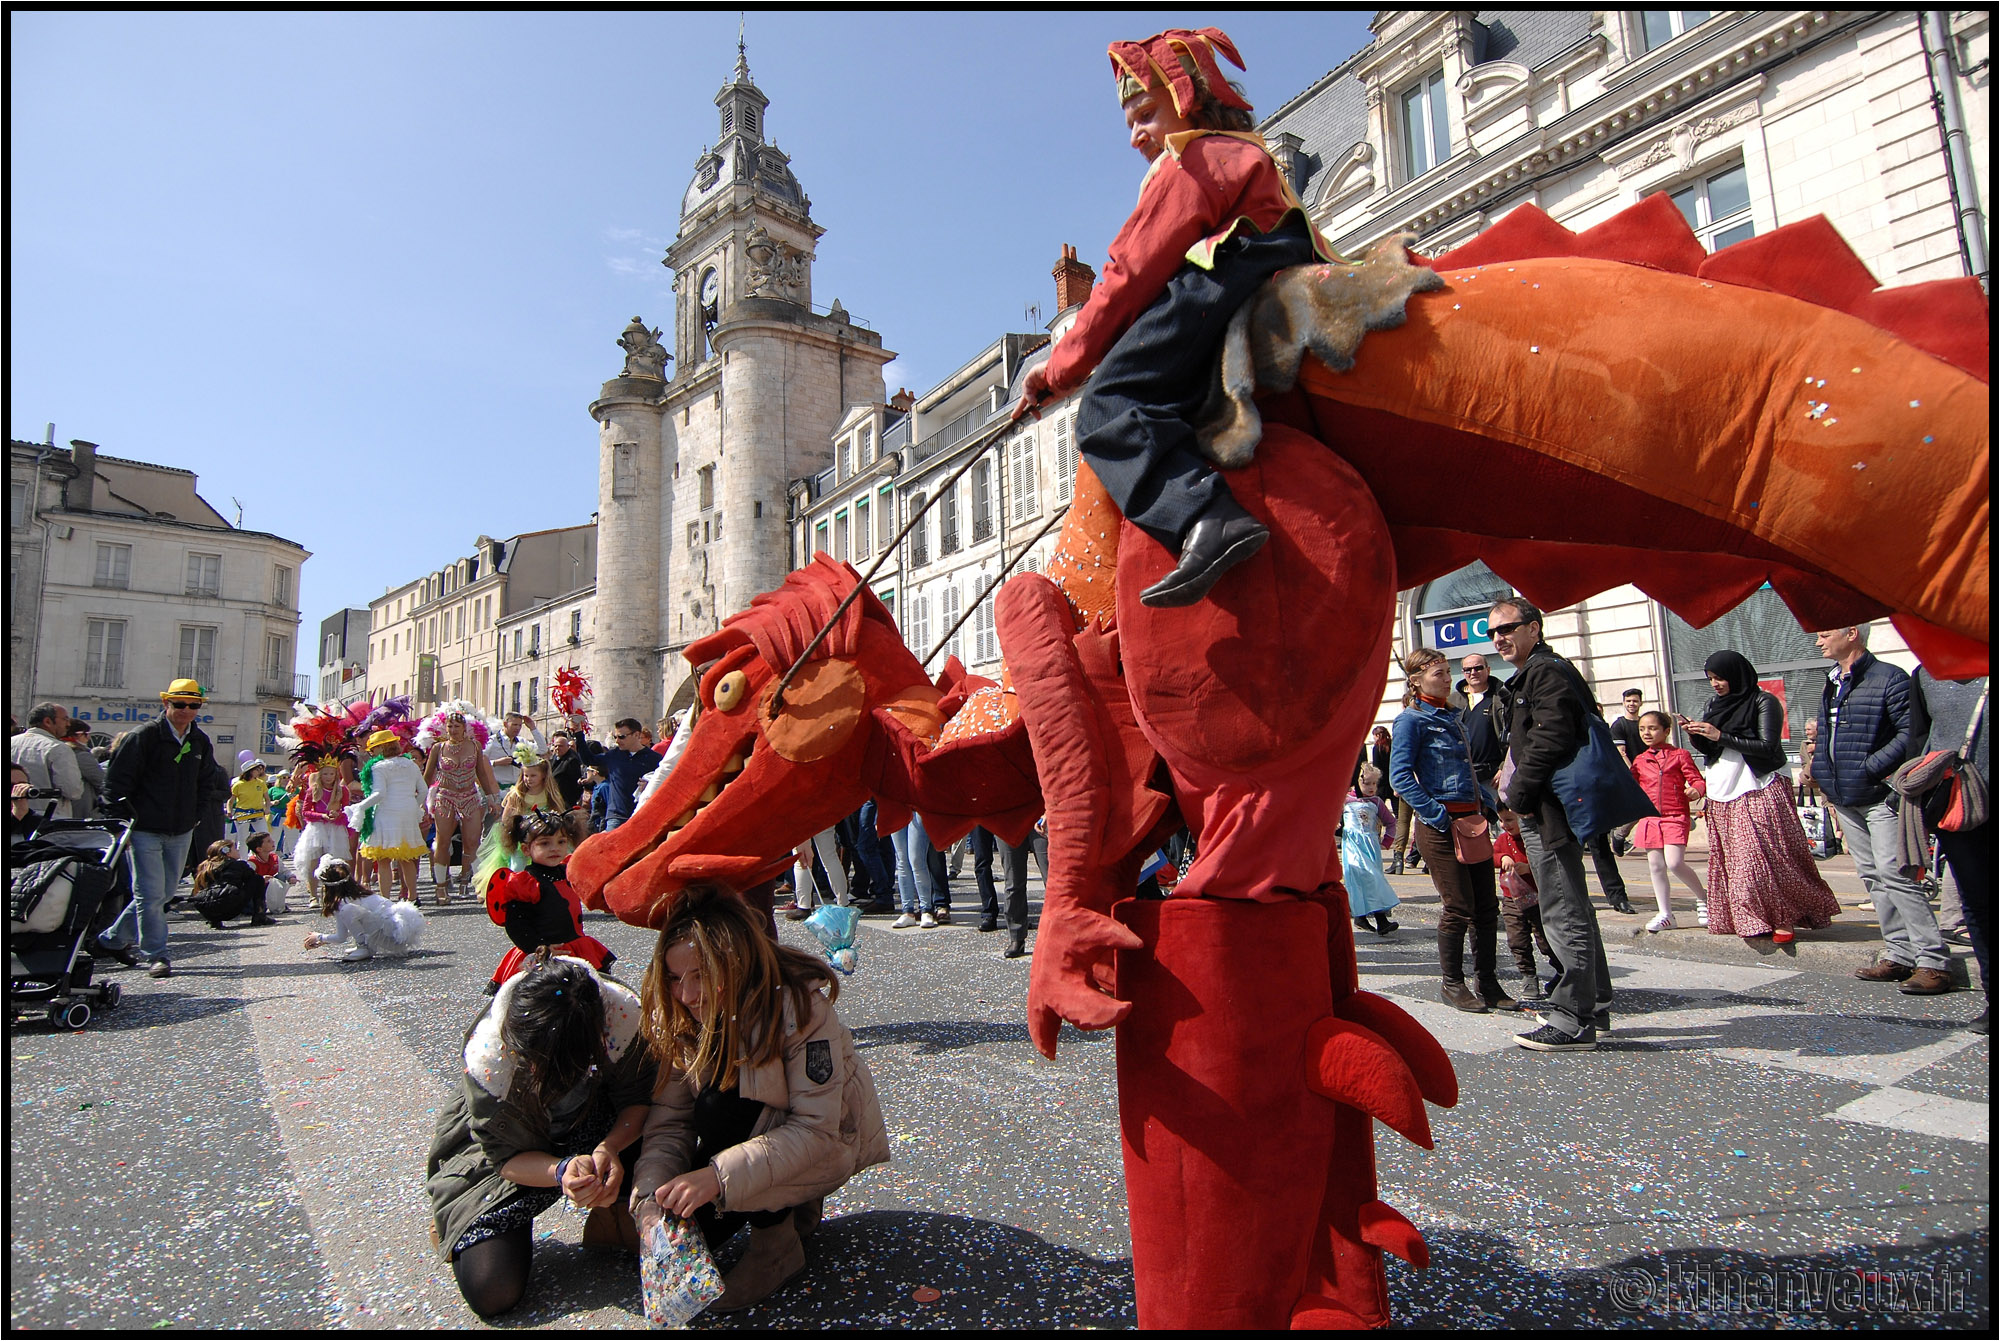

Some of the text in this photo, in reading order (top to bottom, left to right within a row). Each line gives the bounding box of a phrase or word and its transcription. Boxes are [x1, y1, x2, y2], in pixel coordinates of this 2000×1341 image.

[1440, 618, 1488, 643] CIC
[72, 706, 214, 723] la belle-se
